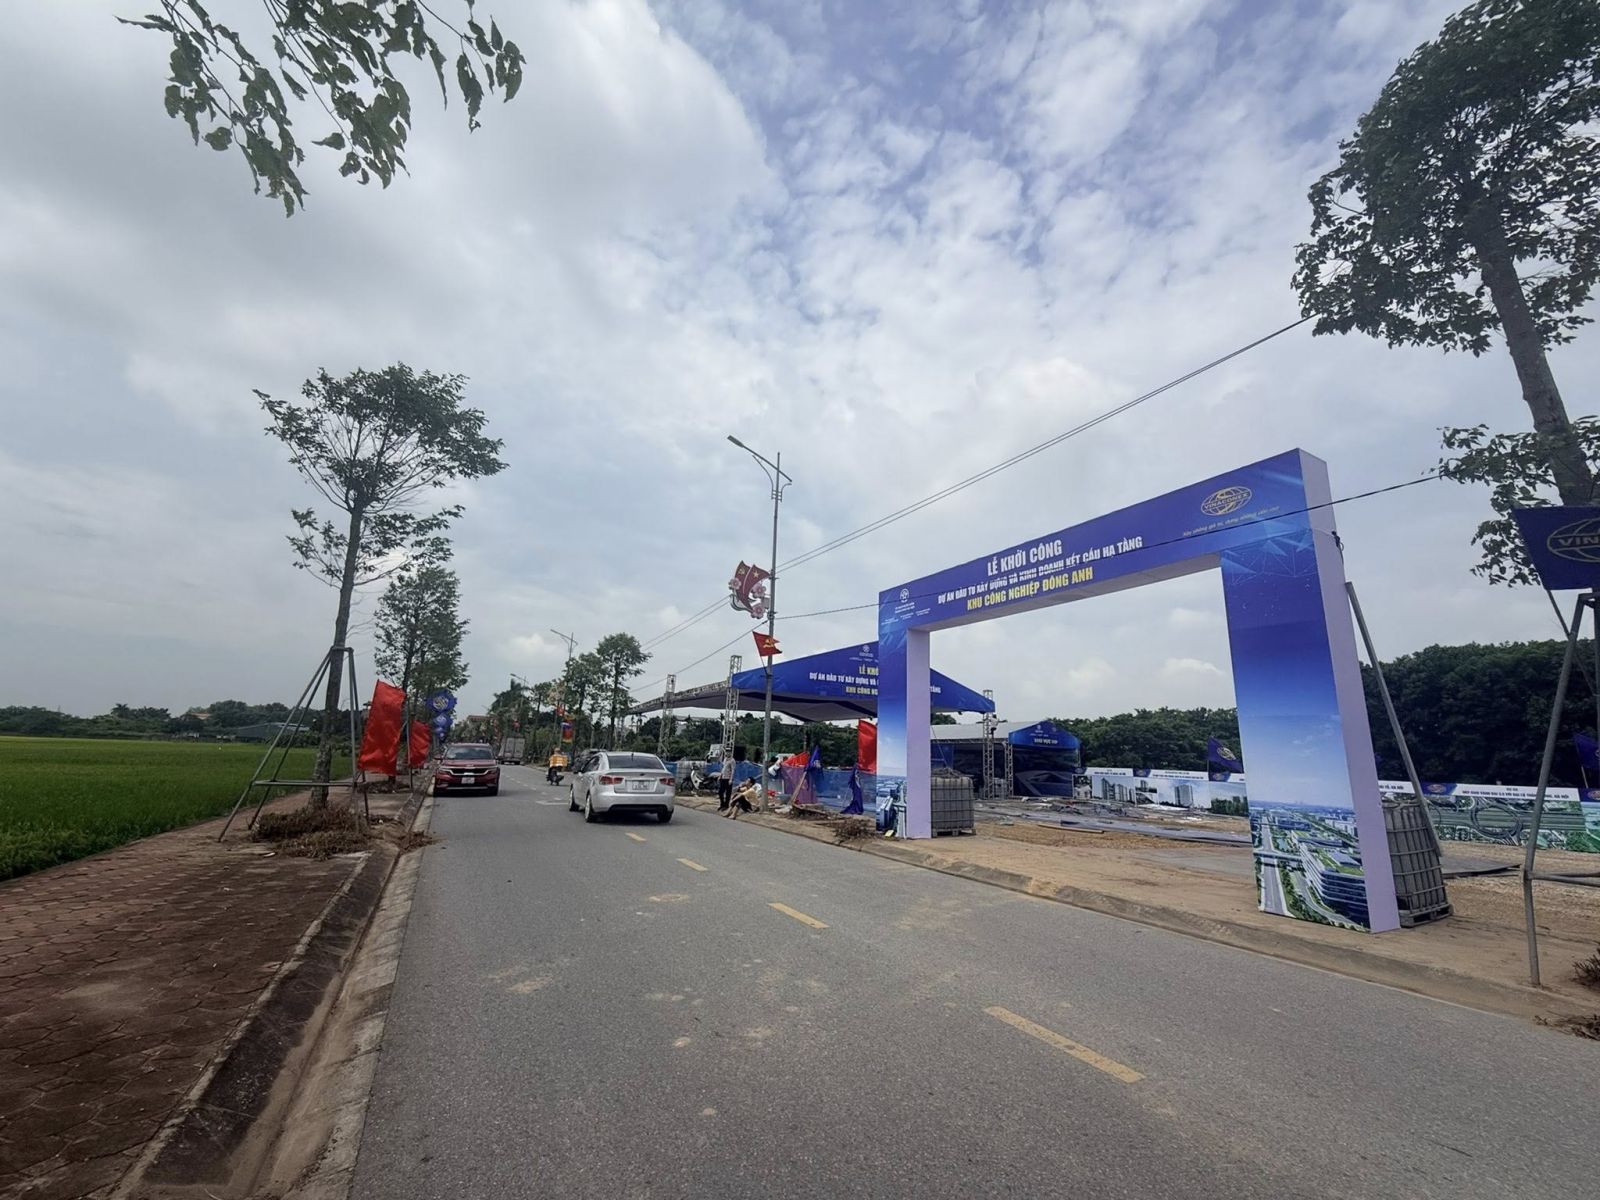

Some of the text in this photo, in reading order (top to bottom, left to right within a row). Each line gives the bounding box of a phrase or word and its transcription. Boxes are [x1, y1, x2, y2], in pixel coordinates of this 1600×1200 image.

[1204, 493, 1249, 510] VINACONEX
[987, 539, 1063, 576] LỄ KHỞI CÔNG
[967, 566, 1094, 611] KHU CÔNG NGHIỆP ĐÔNG ANH
